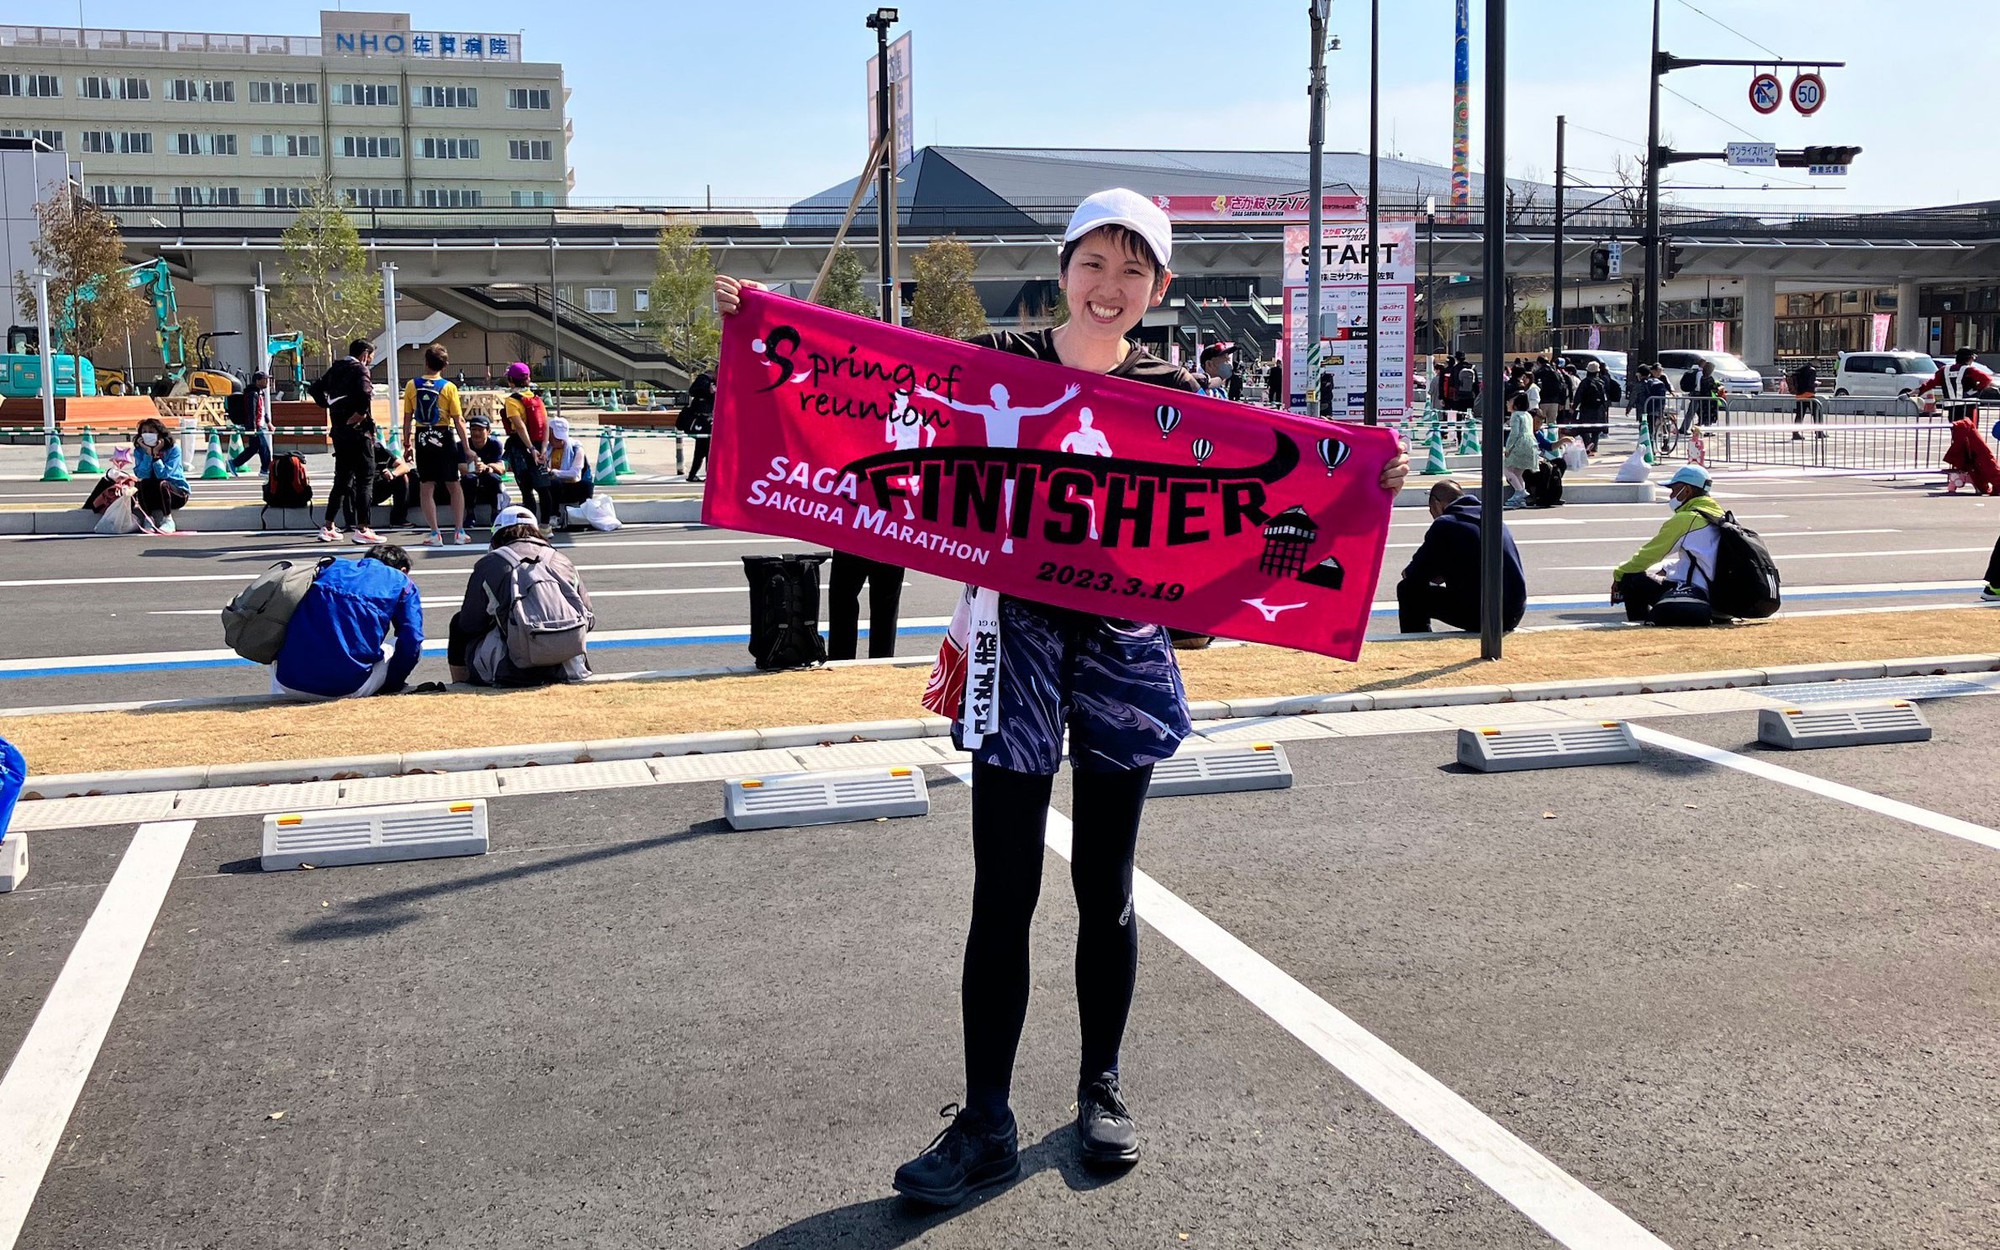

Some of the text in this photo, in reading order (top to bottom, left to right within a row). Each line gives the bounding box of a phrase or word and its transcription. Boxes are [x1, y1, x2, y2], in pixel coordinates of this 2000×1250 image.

[336, 33, 509, 56] NHO 佐賀病院
[1798, 86, 1818, 103] 50
[1729, 146, 1775, 156] サンライズパーク
[1231, 196, 1310, 211] さが桜マラソン
[756, 325, 963, 404] Spring of
[799, 390, 951, 428] reunion
[766, 455, 858, 500] SAGA
[865, 459, 1269, 549] FINISHER
[1035, 560, 1186, 602] 2023.3.19
